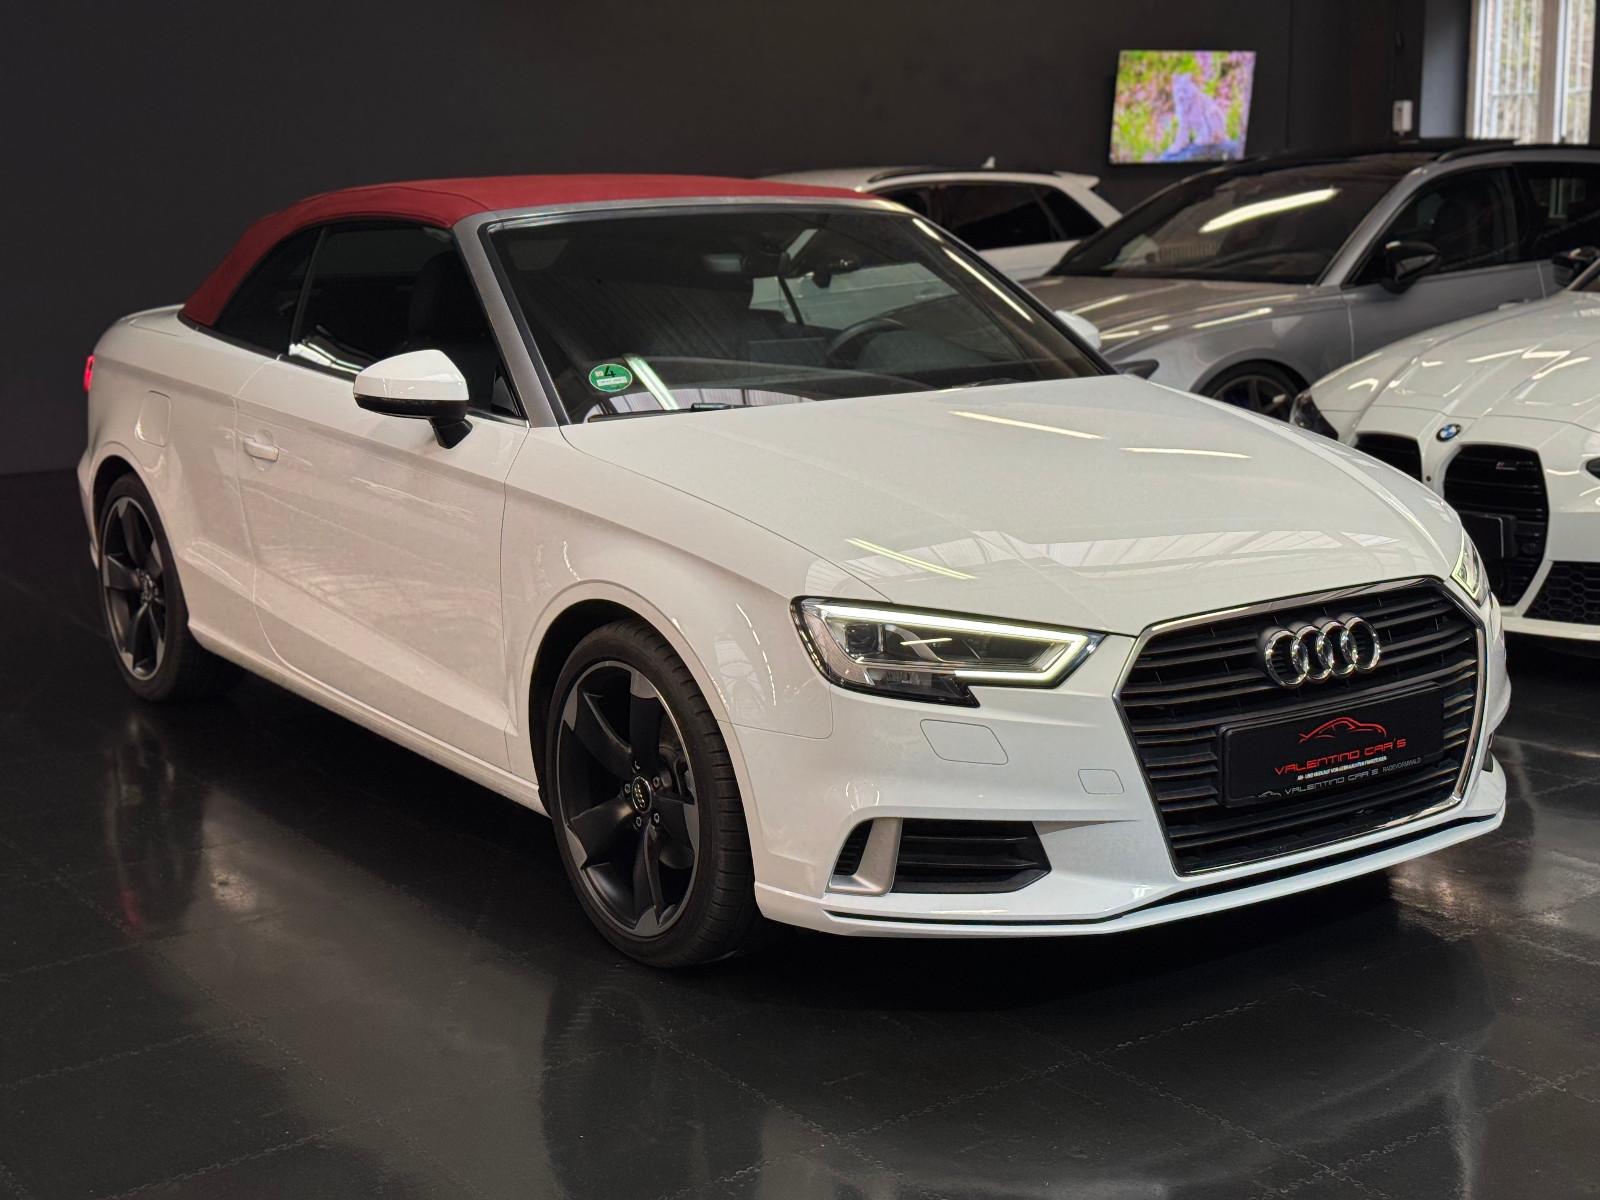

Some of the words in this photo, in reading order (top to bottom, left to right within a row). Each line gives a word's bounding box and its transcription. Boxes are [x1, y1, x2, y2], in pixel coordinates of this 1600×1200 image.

[604, 366, 616, 377] 4
[1274, 750, 1360, 775] VALENTINO
[1364, 738, 1407, 756] CAR'S
[1285, 776, 1345, 795] VALENTINO
